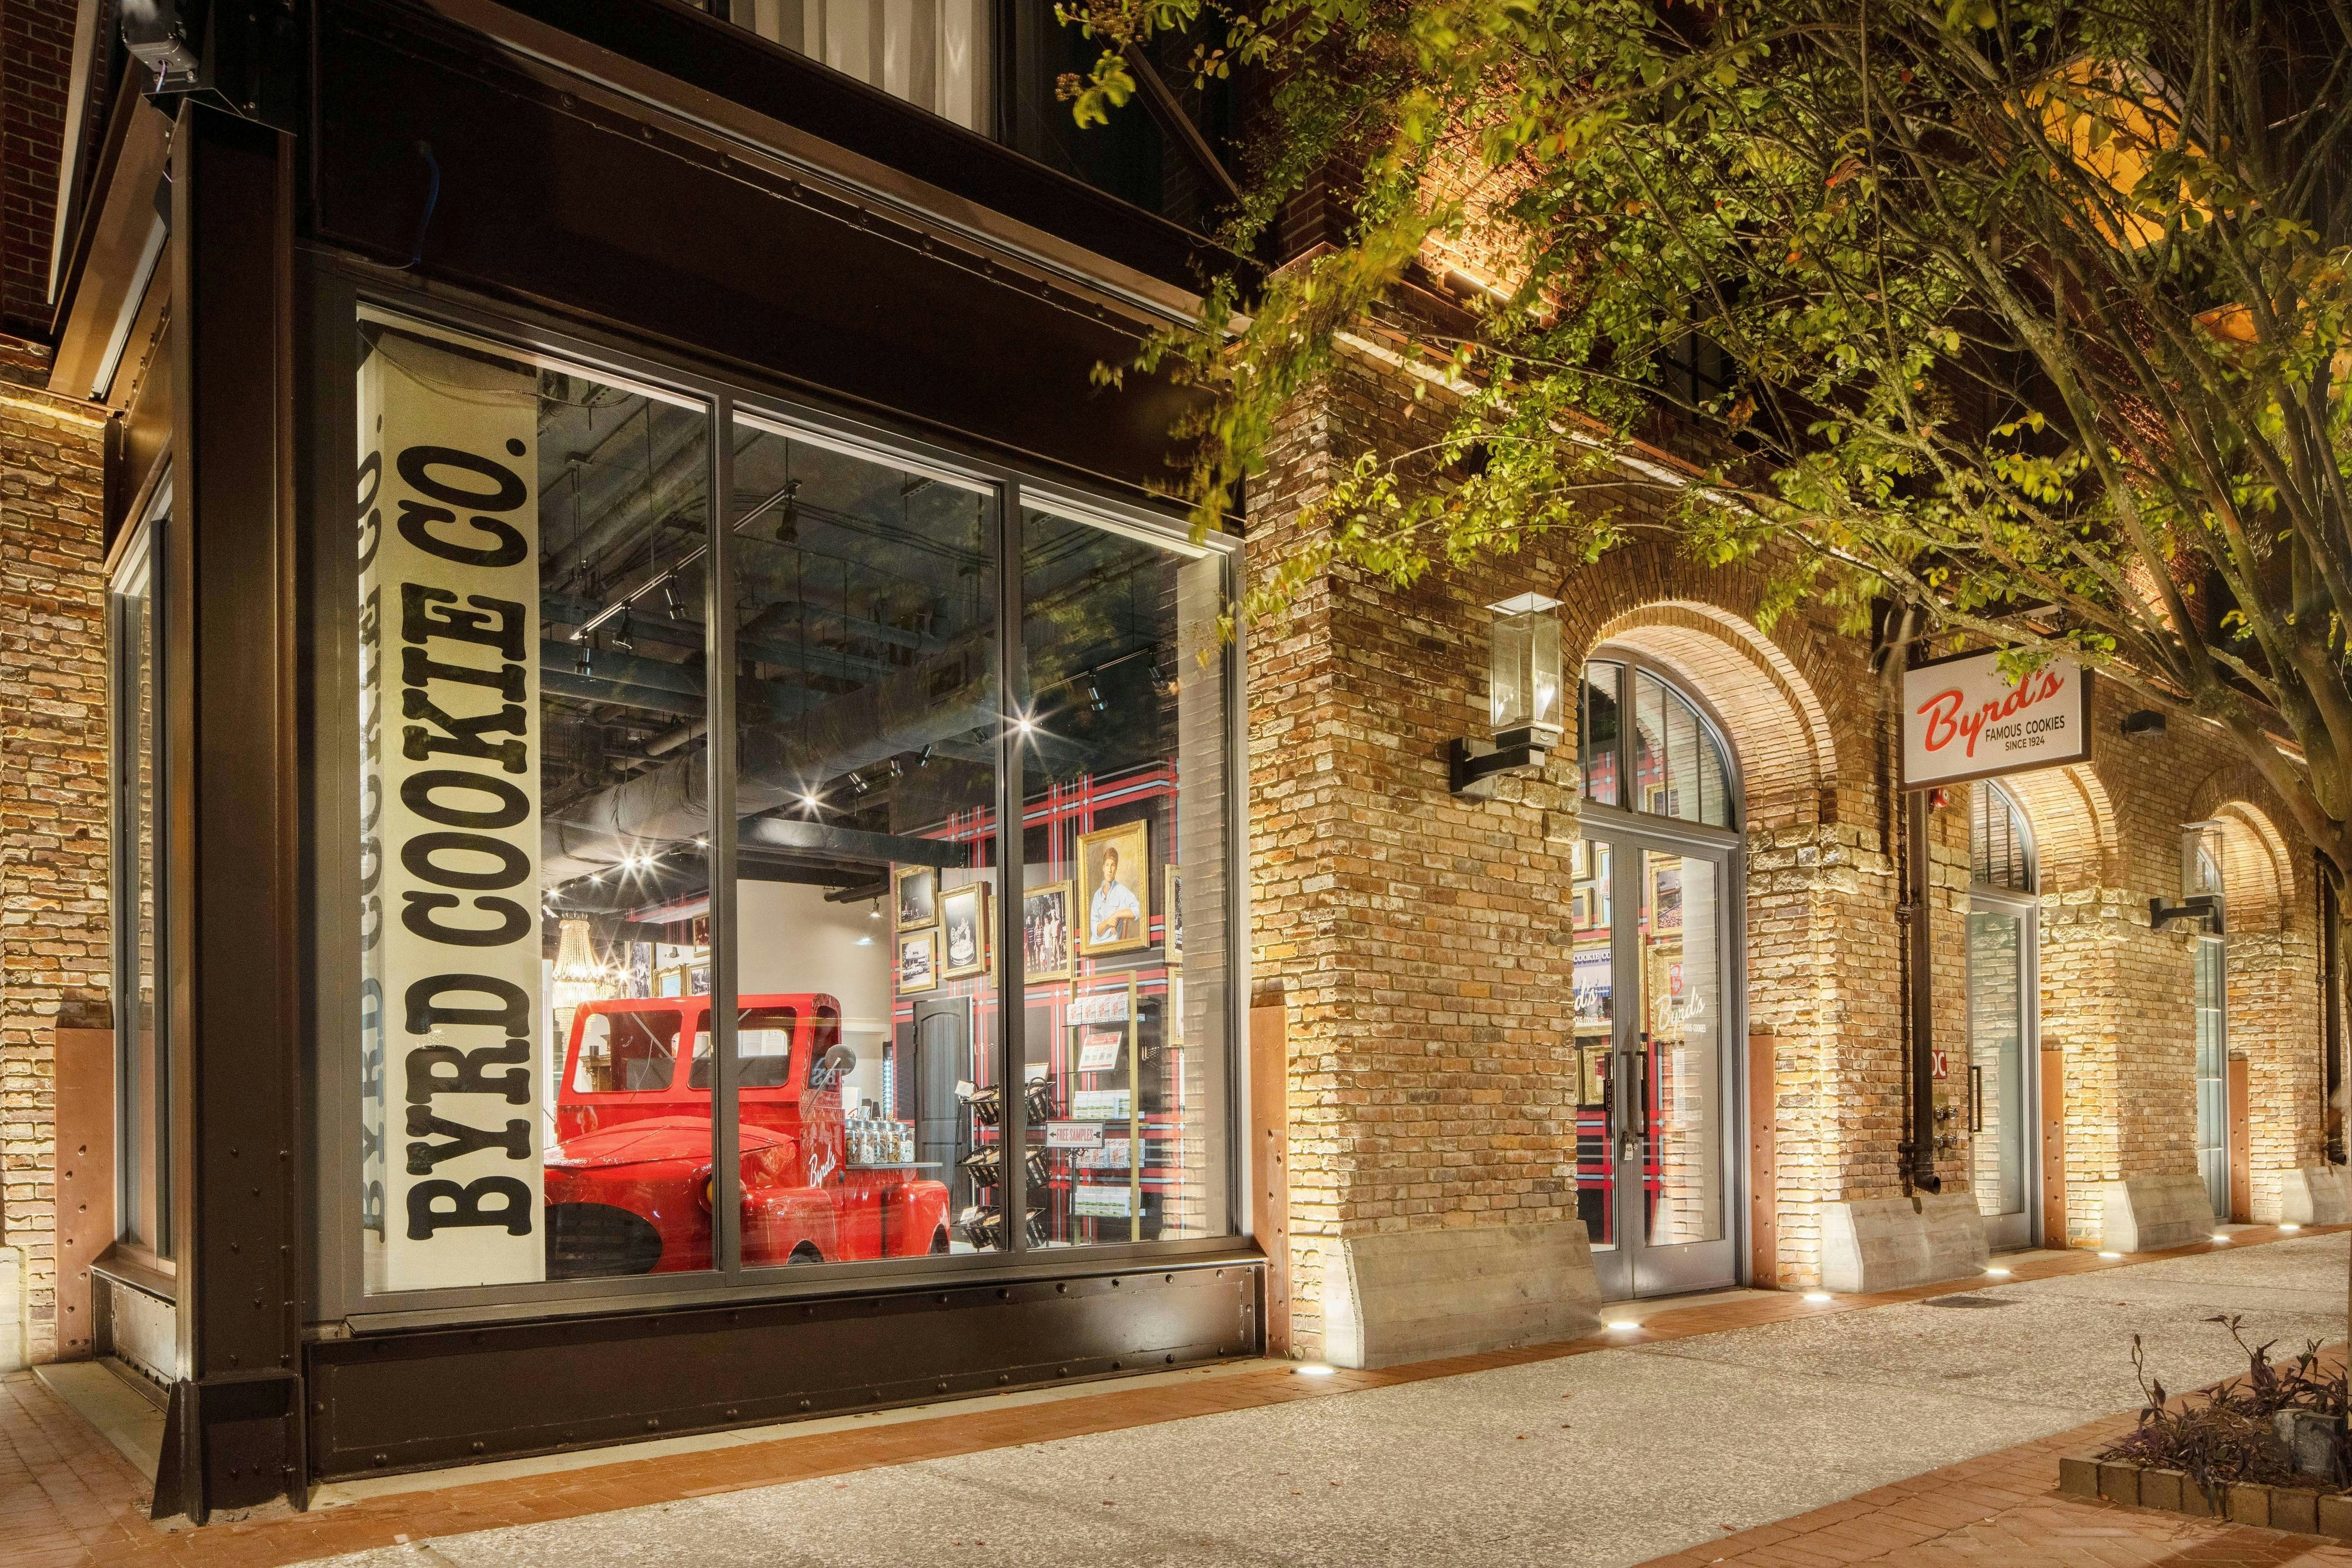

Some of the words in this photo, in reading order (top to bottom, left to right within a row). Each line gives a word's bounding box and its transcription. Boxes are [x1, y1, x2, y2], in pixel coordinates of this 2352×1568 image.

[397, 438, 528, 567] CO.
[1917, 668, 2064, 757] Byrd's
[1986, 723, 2022, 742] FAMOUS
[2026, 716, 2065, 735] COOKIES
[401, 582, 532, 947] COOKIE
[2005, 738, 2027, 751] SINCE
[2029, 735, 2045, 748] 1924
[1655, 986, 1705, 1039] Byrd's
[405, 974, 532, 1241] BYRD
[1057, 1129, 1068, 1141] FREE
[1070, 1128, 1094, 1141] SAMPLES
[809, 1144, 836, 1188] Byrd's
